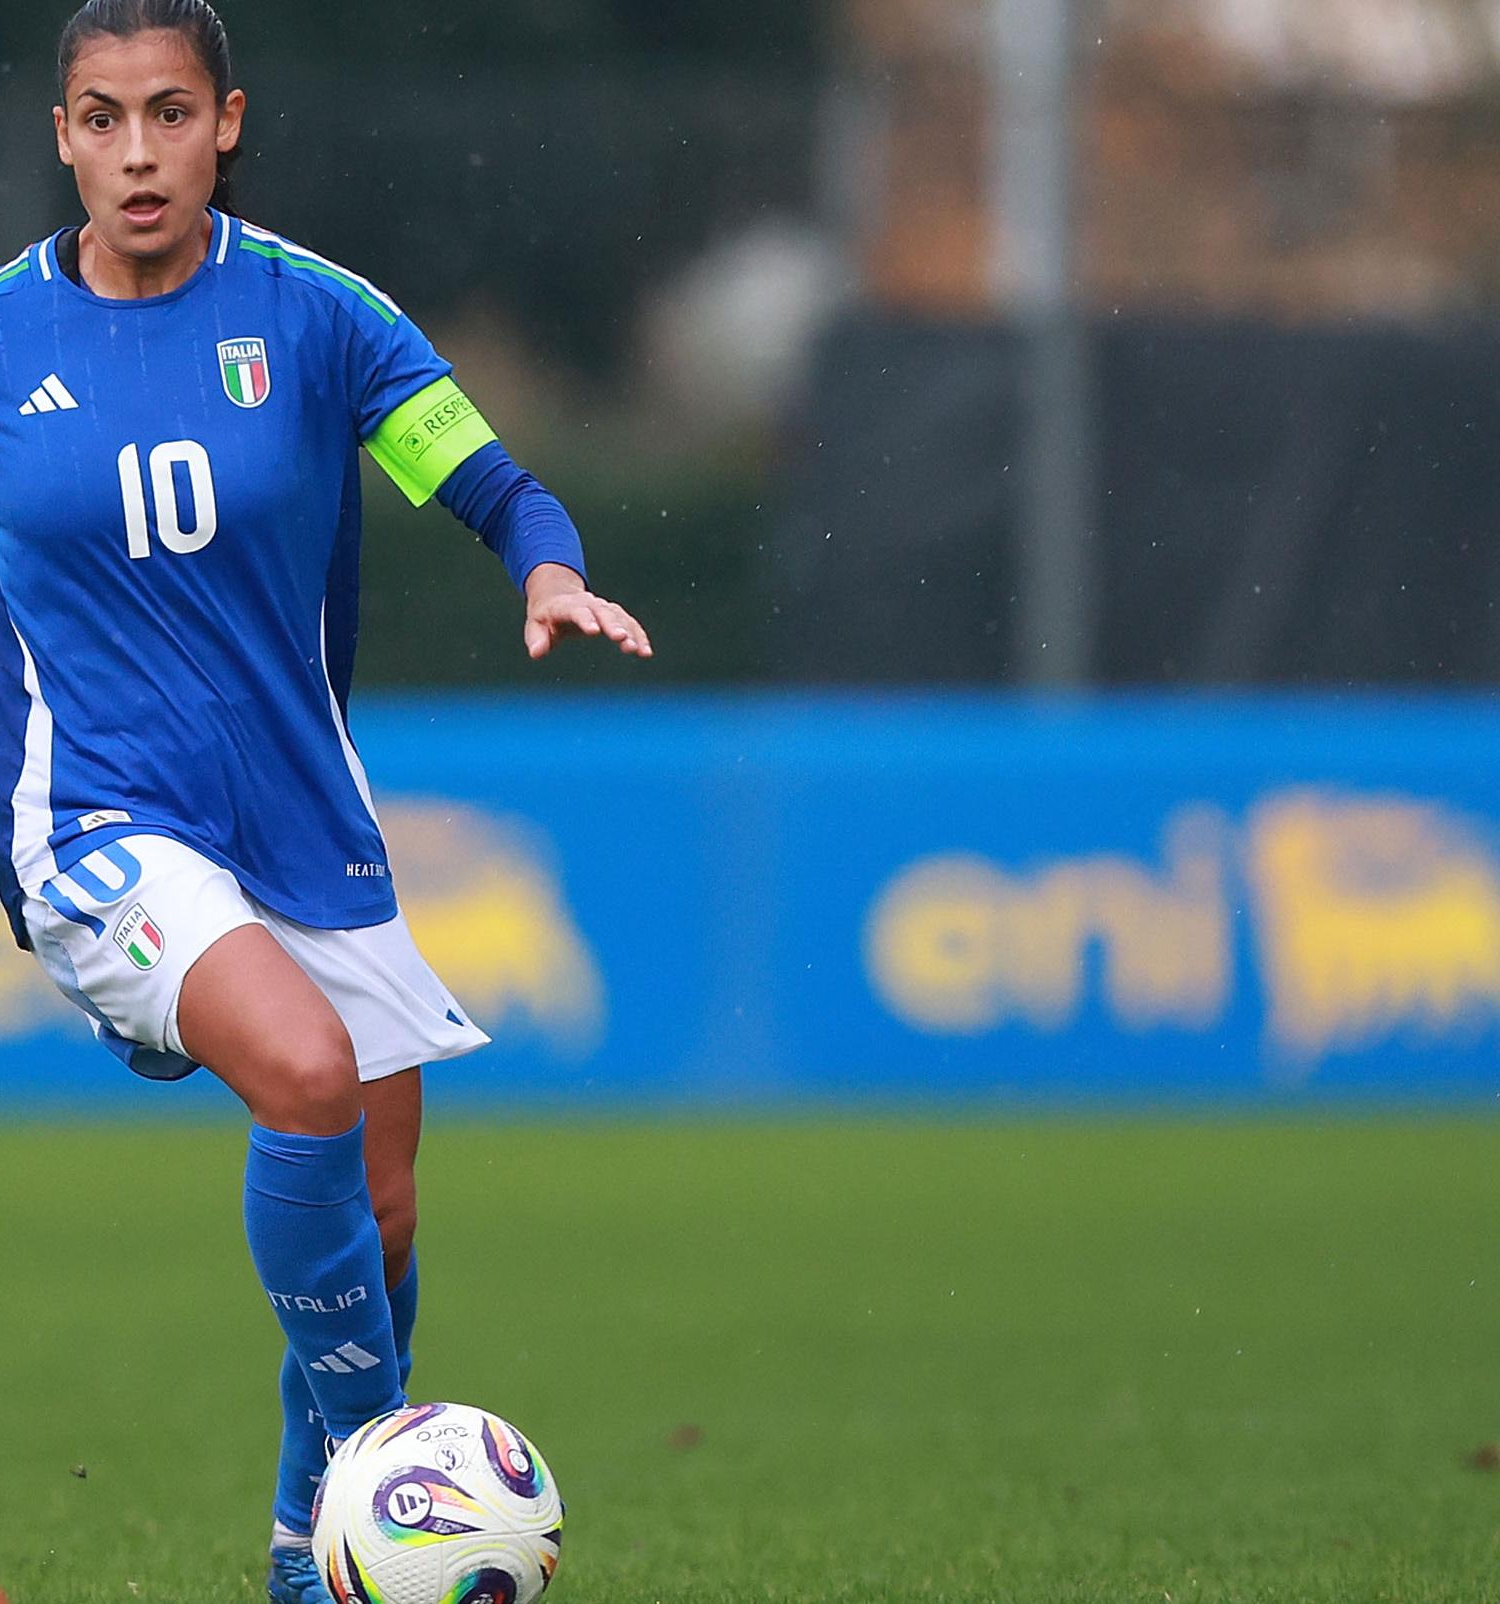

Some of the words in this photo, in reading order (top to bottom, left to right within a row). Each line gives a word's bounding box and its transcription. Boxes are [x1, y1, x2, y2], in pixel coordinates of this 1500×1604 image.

[221, 343, 261, 360] ITALIA
[117, 439, 217, 559] 10
[116, 909, 142, 945] ITALIA
[266, 1285, 368, 1313] ITALIA
